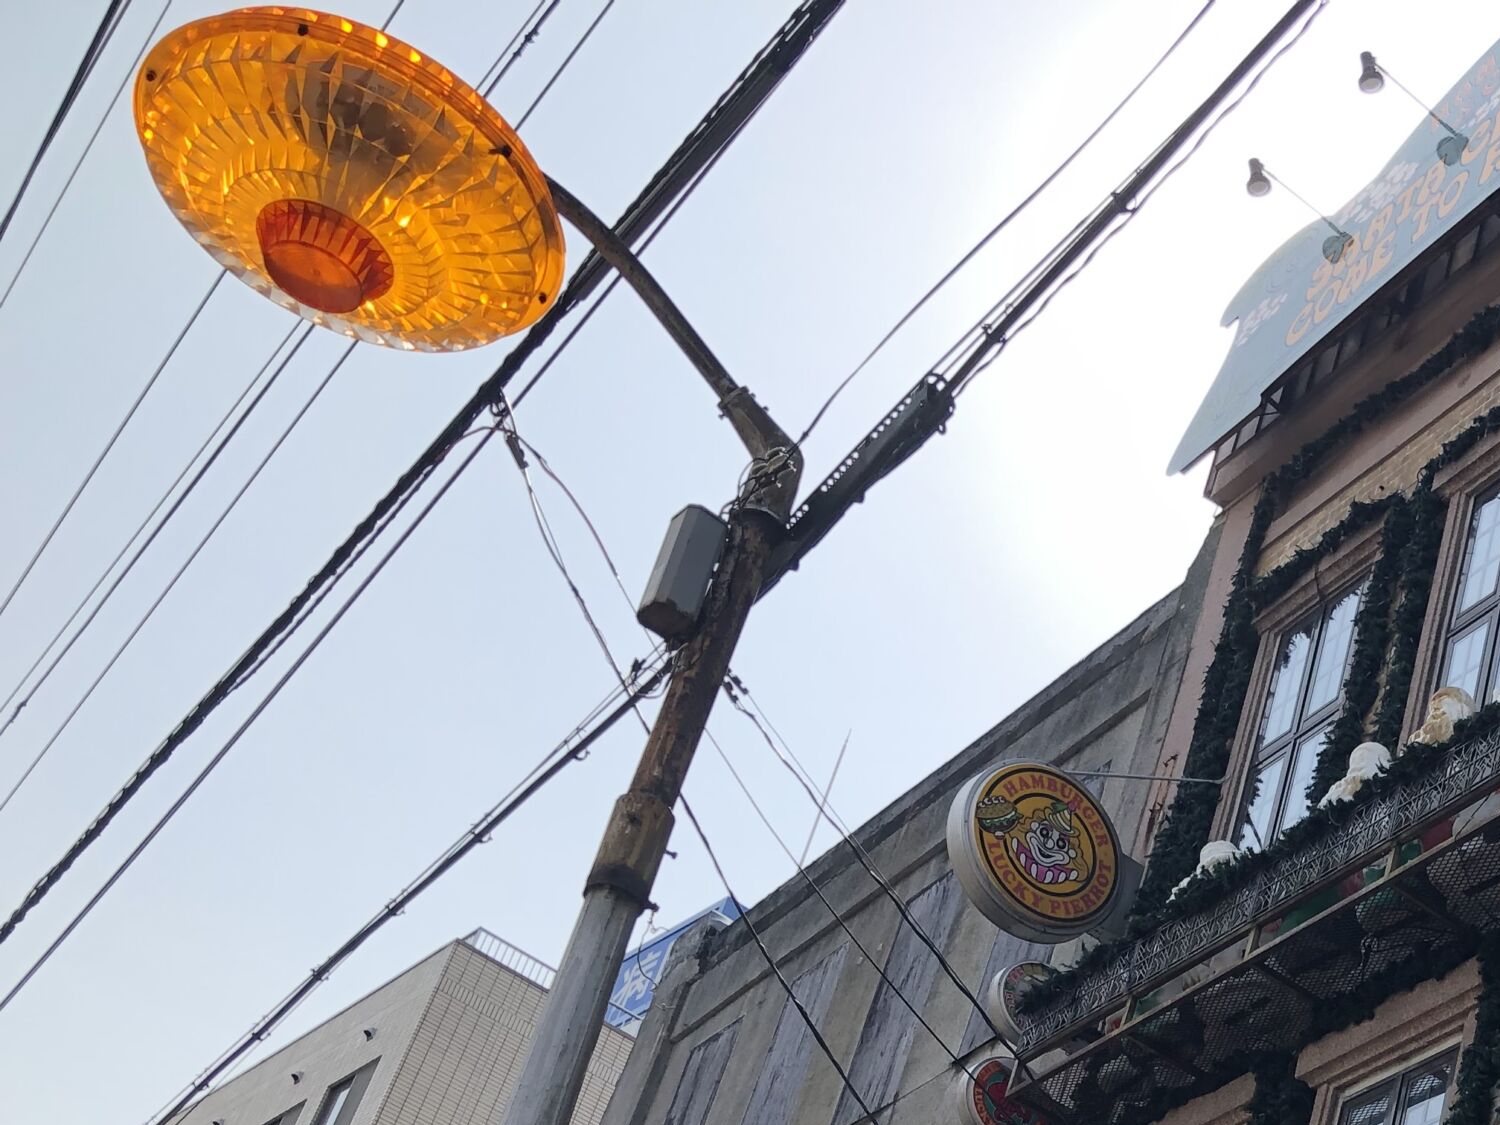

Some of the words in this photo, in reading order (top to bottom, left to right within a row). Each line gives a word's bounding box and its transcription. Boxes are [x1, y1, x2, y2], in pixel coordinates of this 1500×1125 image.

[1284, 231, 1396, 347] COME
[1410, 170, 1469, 244] TO
[1003, 774, 1109, 850] HAMBURGER
[987, 838, 1042, 909] LUCKY
[1048, 860, 1112, 918] PIERROT
